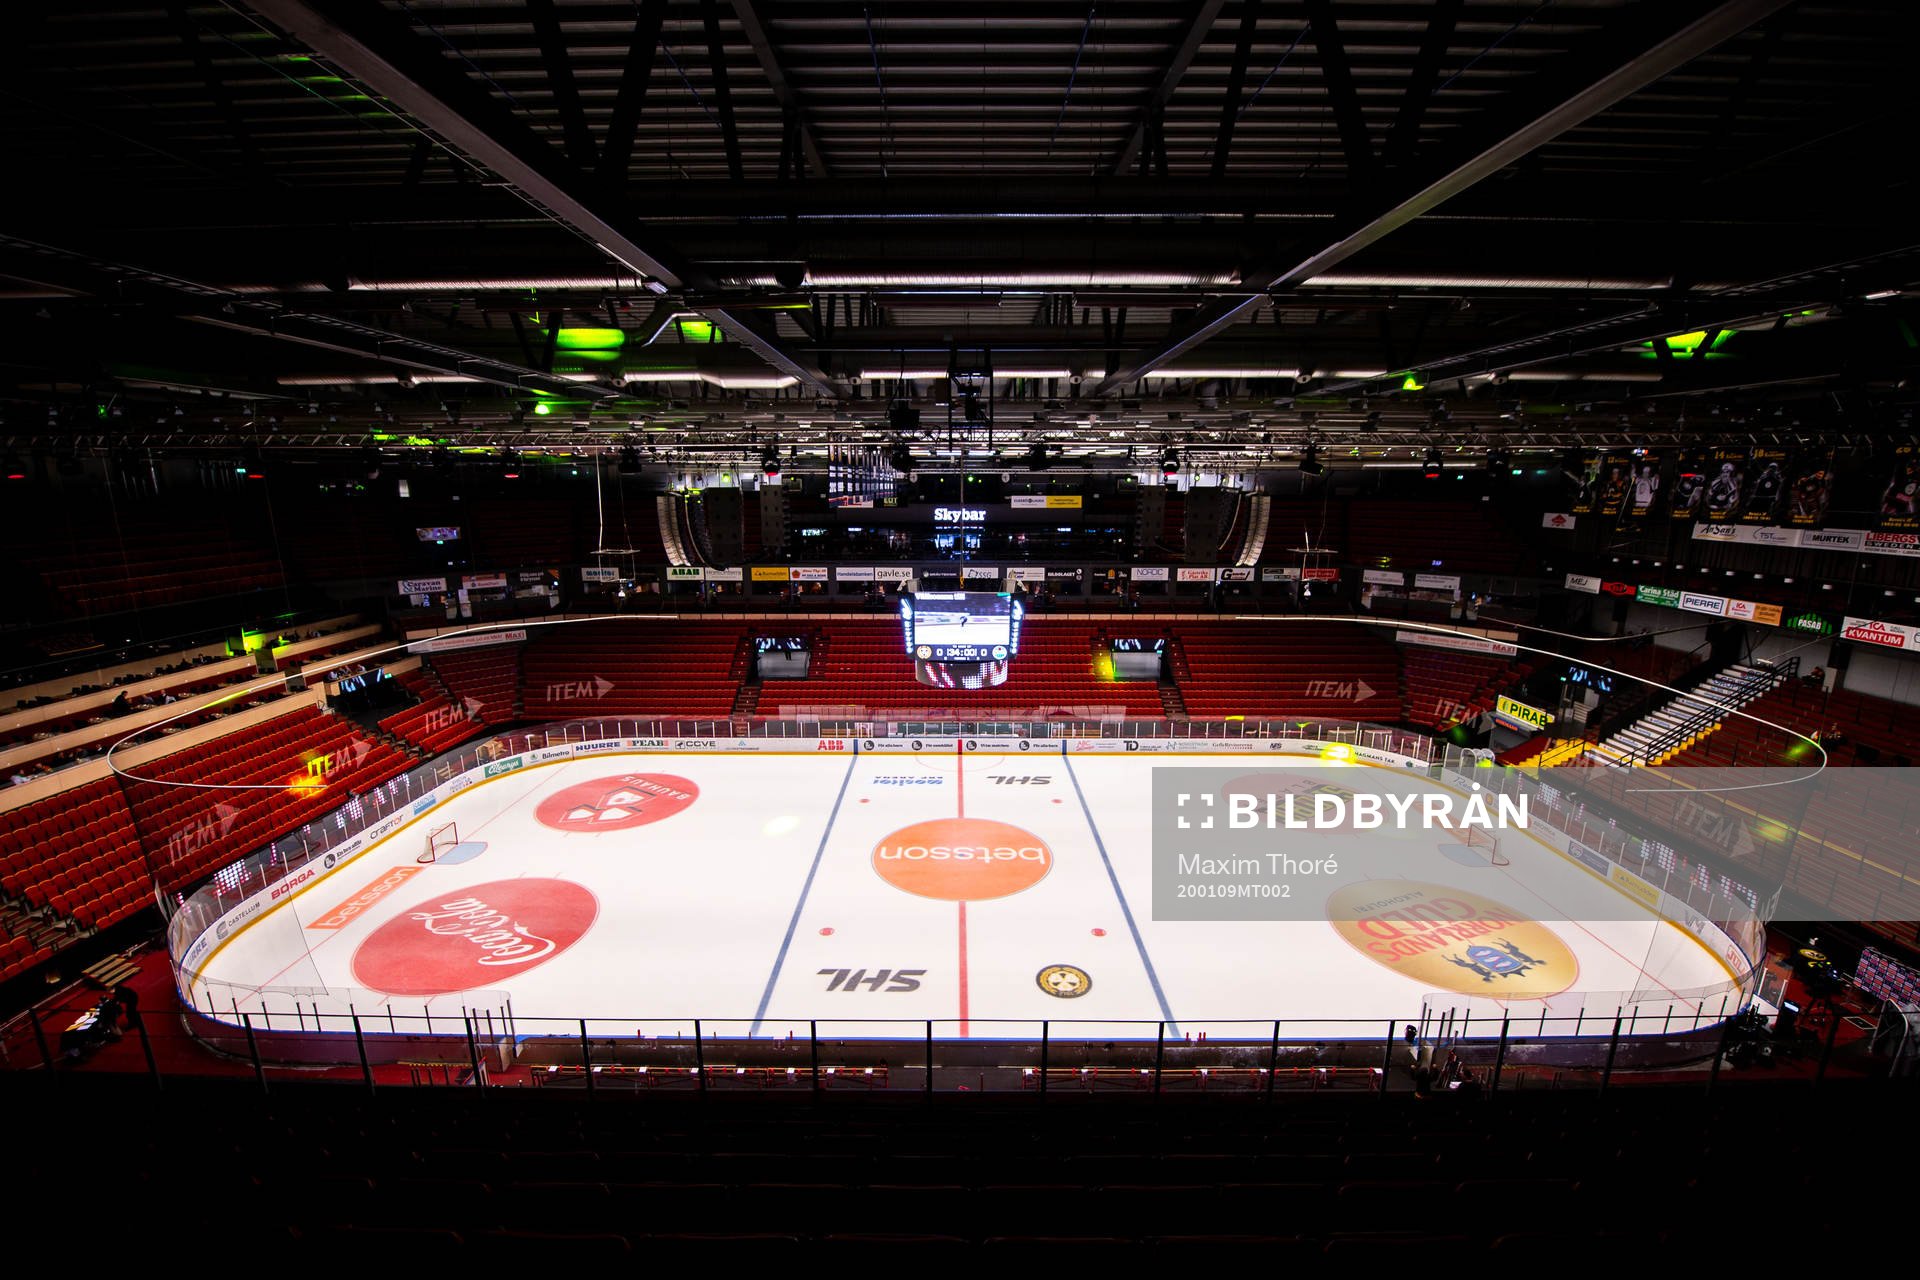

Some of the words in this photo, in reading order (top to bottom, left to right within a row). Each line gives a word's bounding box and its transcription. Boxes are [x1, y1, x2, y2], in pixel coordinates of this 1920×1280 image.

[934, 507, 986, 523] Skybar
[1812, 534, 1850, 543] MURTEK
[1685, 597, 1721, 609] PIERRE
[1797, 618, 1822, 630] PASAB
[1869, 621, 1885, 632] ICA
[1848, 629, 1902, 645] KVANTUM
[546, 680, 593, 702] ITEM
[1304, 679, 1353, 699] ITEM
[425, 702, 463, 733] ITEM
[1509, 703, 1548, 727] PIRAB
[575, 741, 621, 751] HUURRE
[631, 739, 664, 747] PEAB
[817, 740, 844, 751] ABB
[307, 749, 352, 780] ITEM
[542, 750, 569, 760] Bilmetro
[617, 775, 692, 800] BAUHAUS
[986, 775, 1053, 785] SHL
[880, 846, 1045, 865] betsson
[271, 868, 315, 900] BORGA
[318, 867, 415, 928] betsson
[1352, 890, 1424, 914] ALKOHOLFRI
[228, 901, 261, 927] CASTELLUM
[1356, 897, 1476, 940] GULD
[1364, 907, 1524, 963] NORRLANDS
[1727, 949, 1746, 976] JUL
[816, 968, 928, 993] SHL
